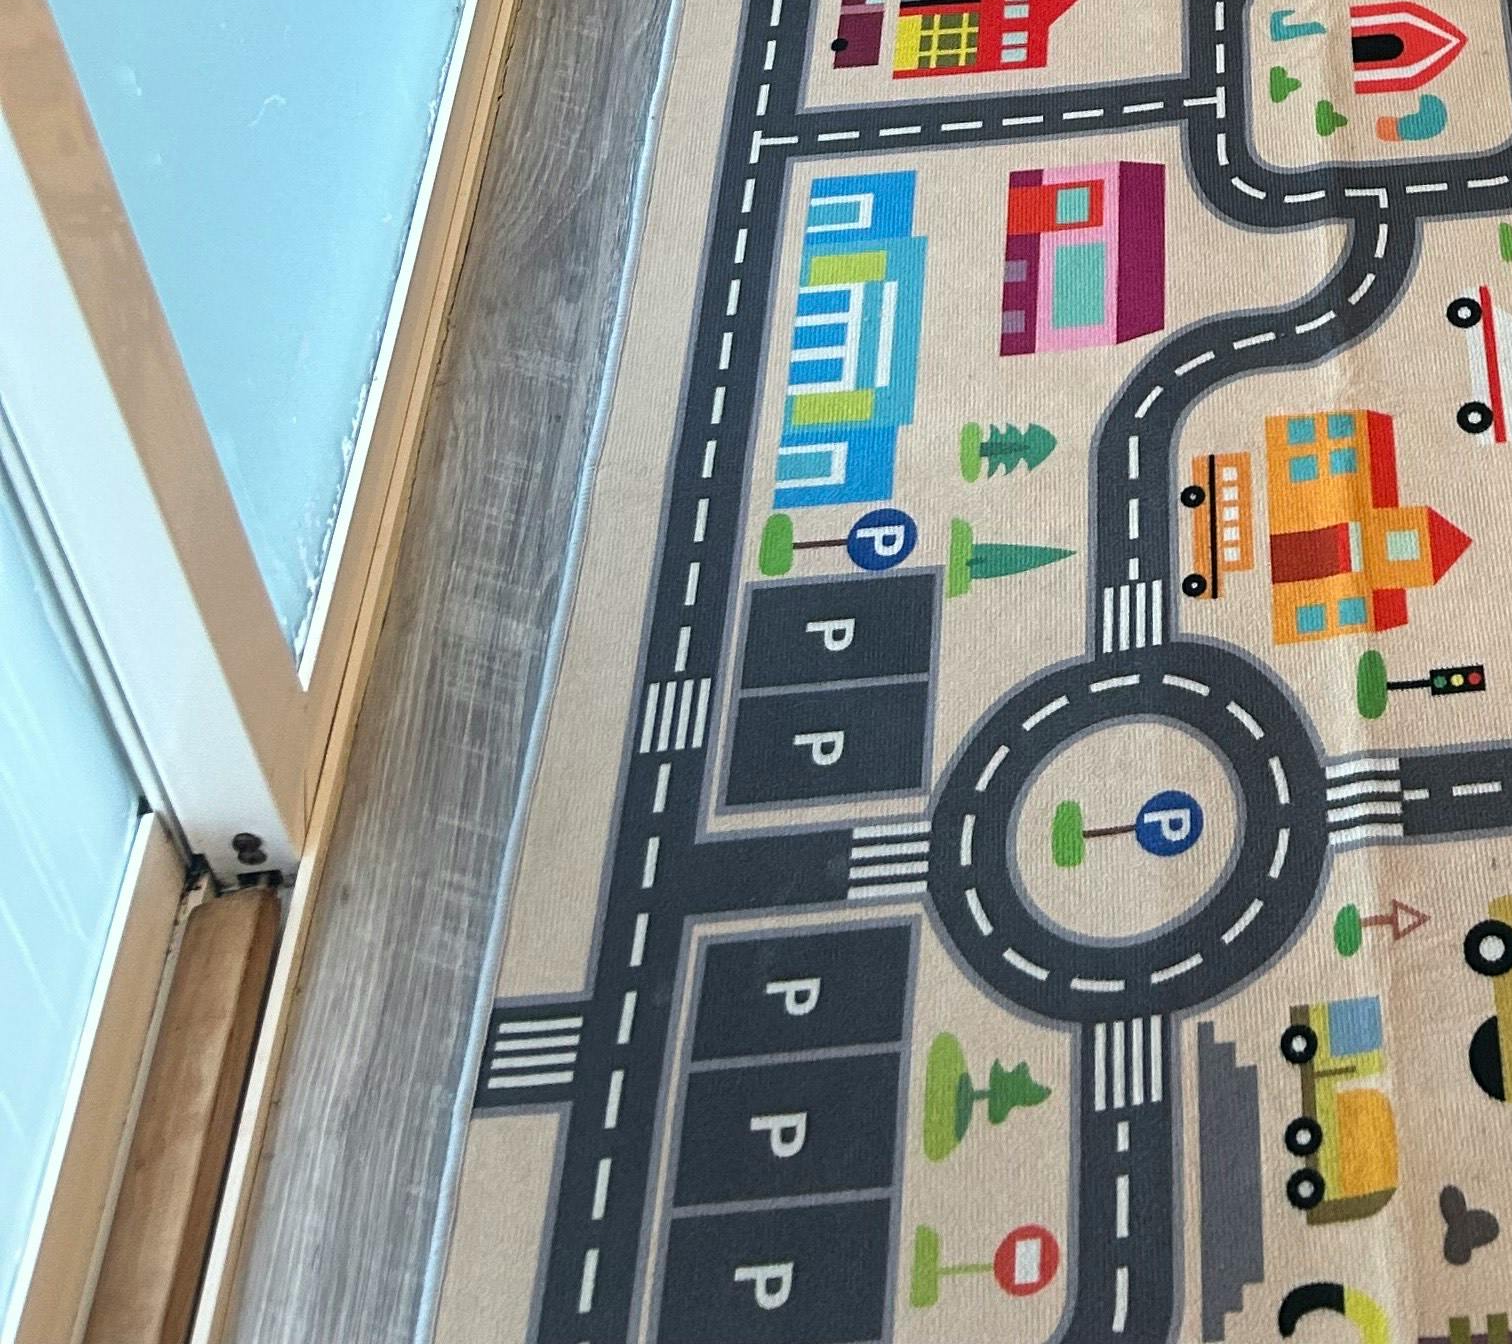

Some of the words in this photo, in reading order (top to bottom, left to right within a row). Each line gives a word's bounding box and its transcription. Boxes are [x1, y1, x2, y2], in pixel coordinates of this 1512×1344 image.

[854, 524, 906, 560] P
[805, 619, 856, 652] P
[794, 730, 845, 766] P
[1142, 810, 1193, 844] P
[766, 978, 821, 1016] P
[750, 1114, 807, 1158] P
[734, 1265, 794, 1309] P
